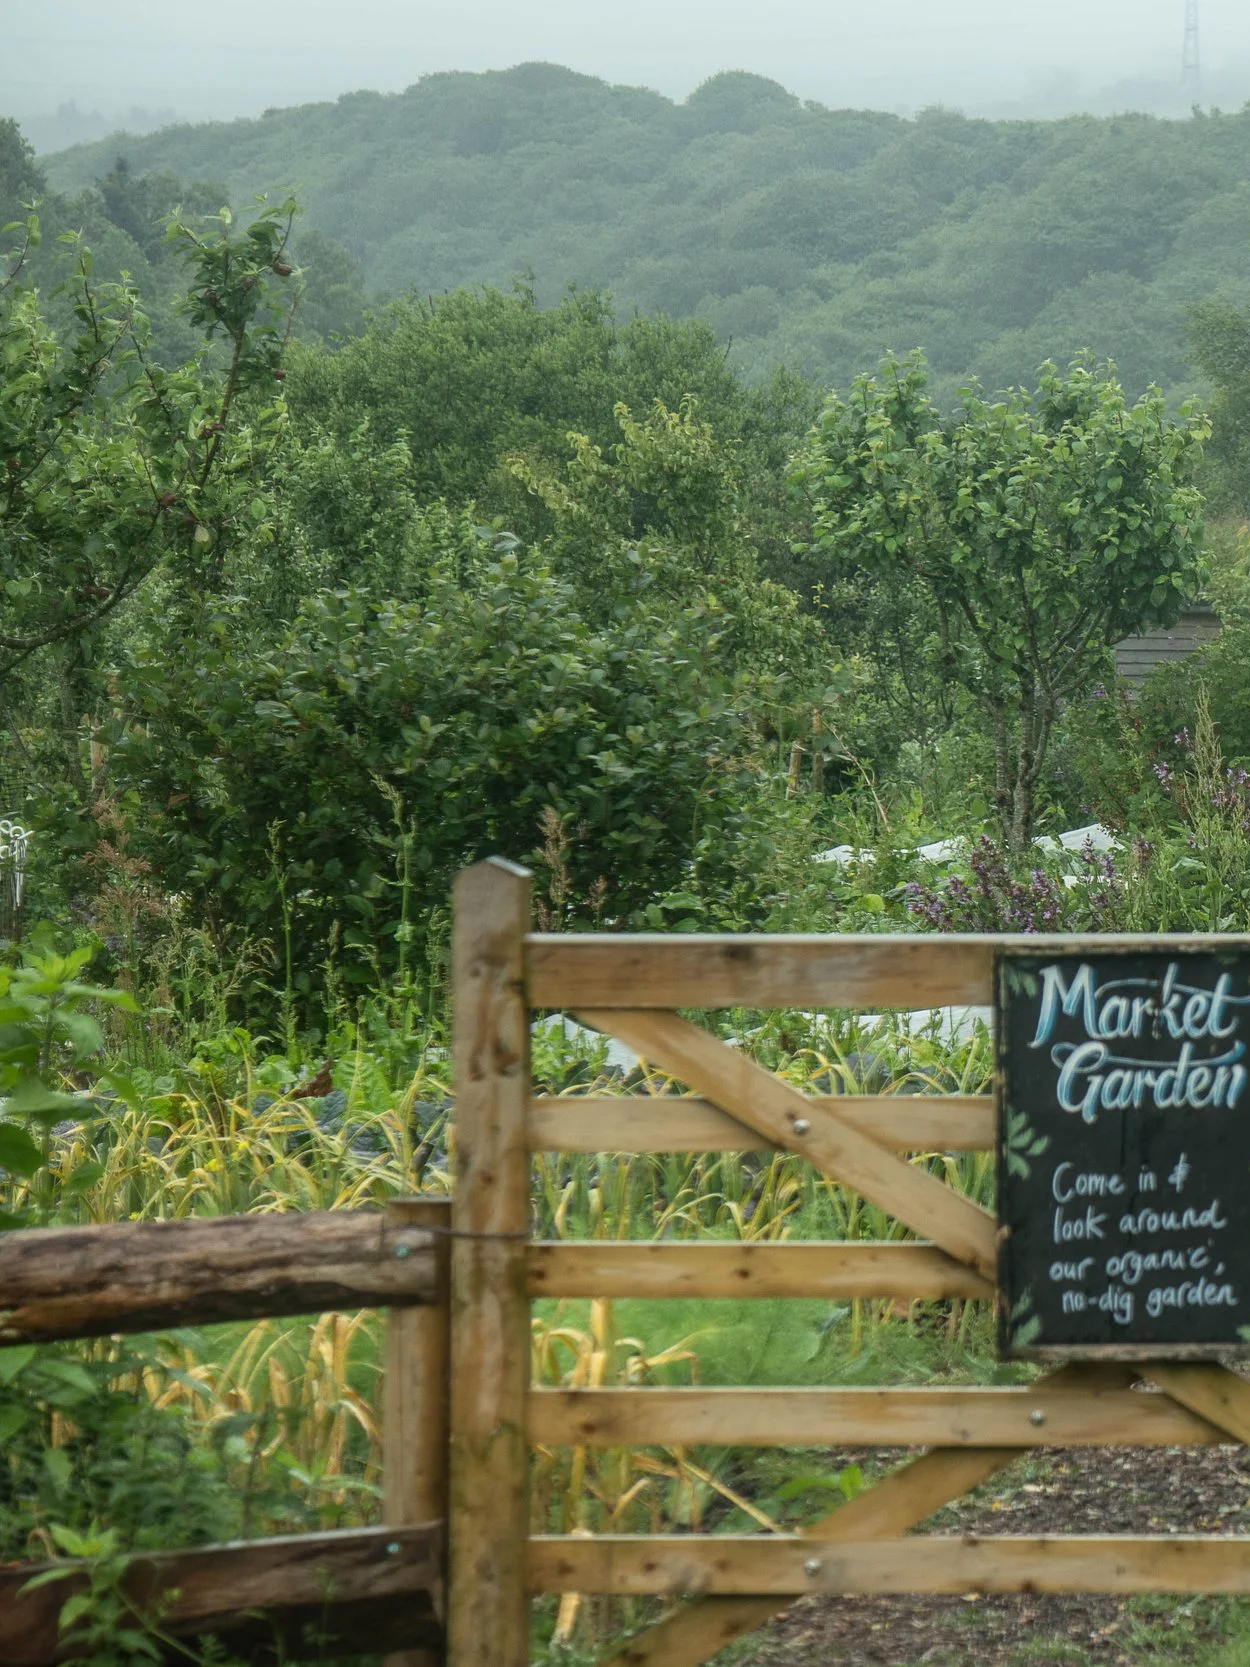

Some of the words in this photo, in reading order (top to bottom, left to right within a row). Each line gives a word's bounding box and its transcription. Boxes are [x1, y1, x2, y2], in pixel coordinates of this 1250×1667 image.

[1051, 1040, 1247, 1125] Garden
[1052, 1161, 1127, 1203] Come
[1138, 1164, 1157, 1192] in
[1053, 1204, 1110, 1244] look
[1119, 1200, 1228, 1234] around
[1049, 1256, 1096, 1281] our
[1062, 1284, 1135, 1325] no-dig
[1145, 1276, 1239, 1318] garden
